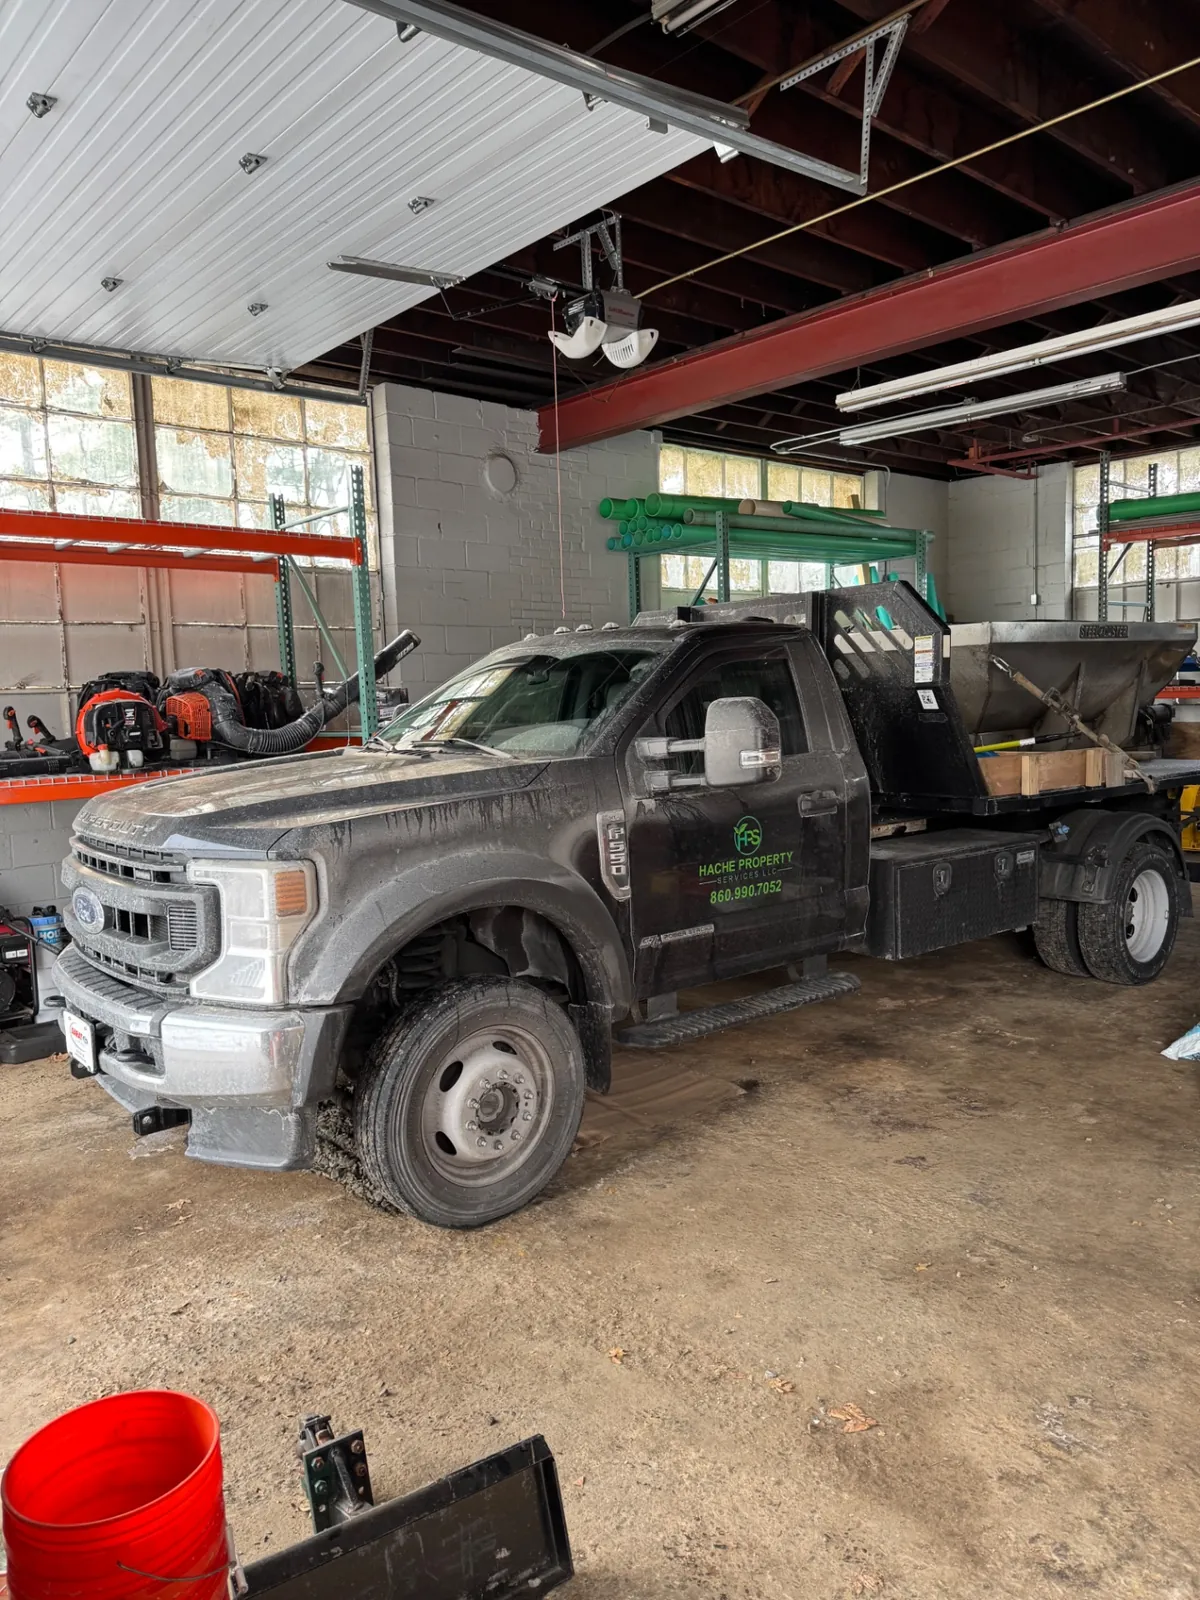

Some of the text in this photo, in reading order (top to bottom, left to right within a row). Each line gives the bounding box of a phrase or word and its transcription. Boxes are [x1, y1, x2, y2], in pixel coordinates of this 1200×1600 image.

[699, 851, 794, 877] HACHE PROPERTY
[716, 867, 778, 884] SERVICES LLC
[710, 879, 782, 904] 860.990.7052
